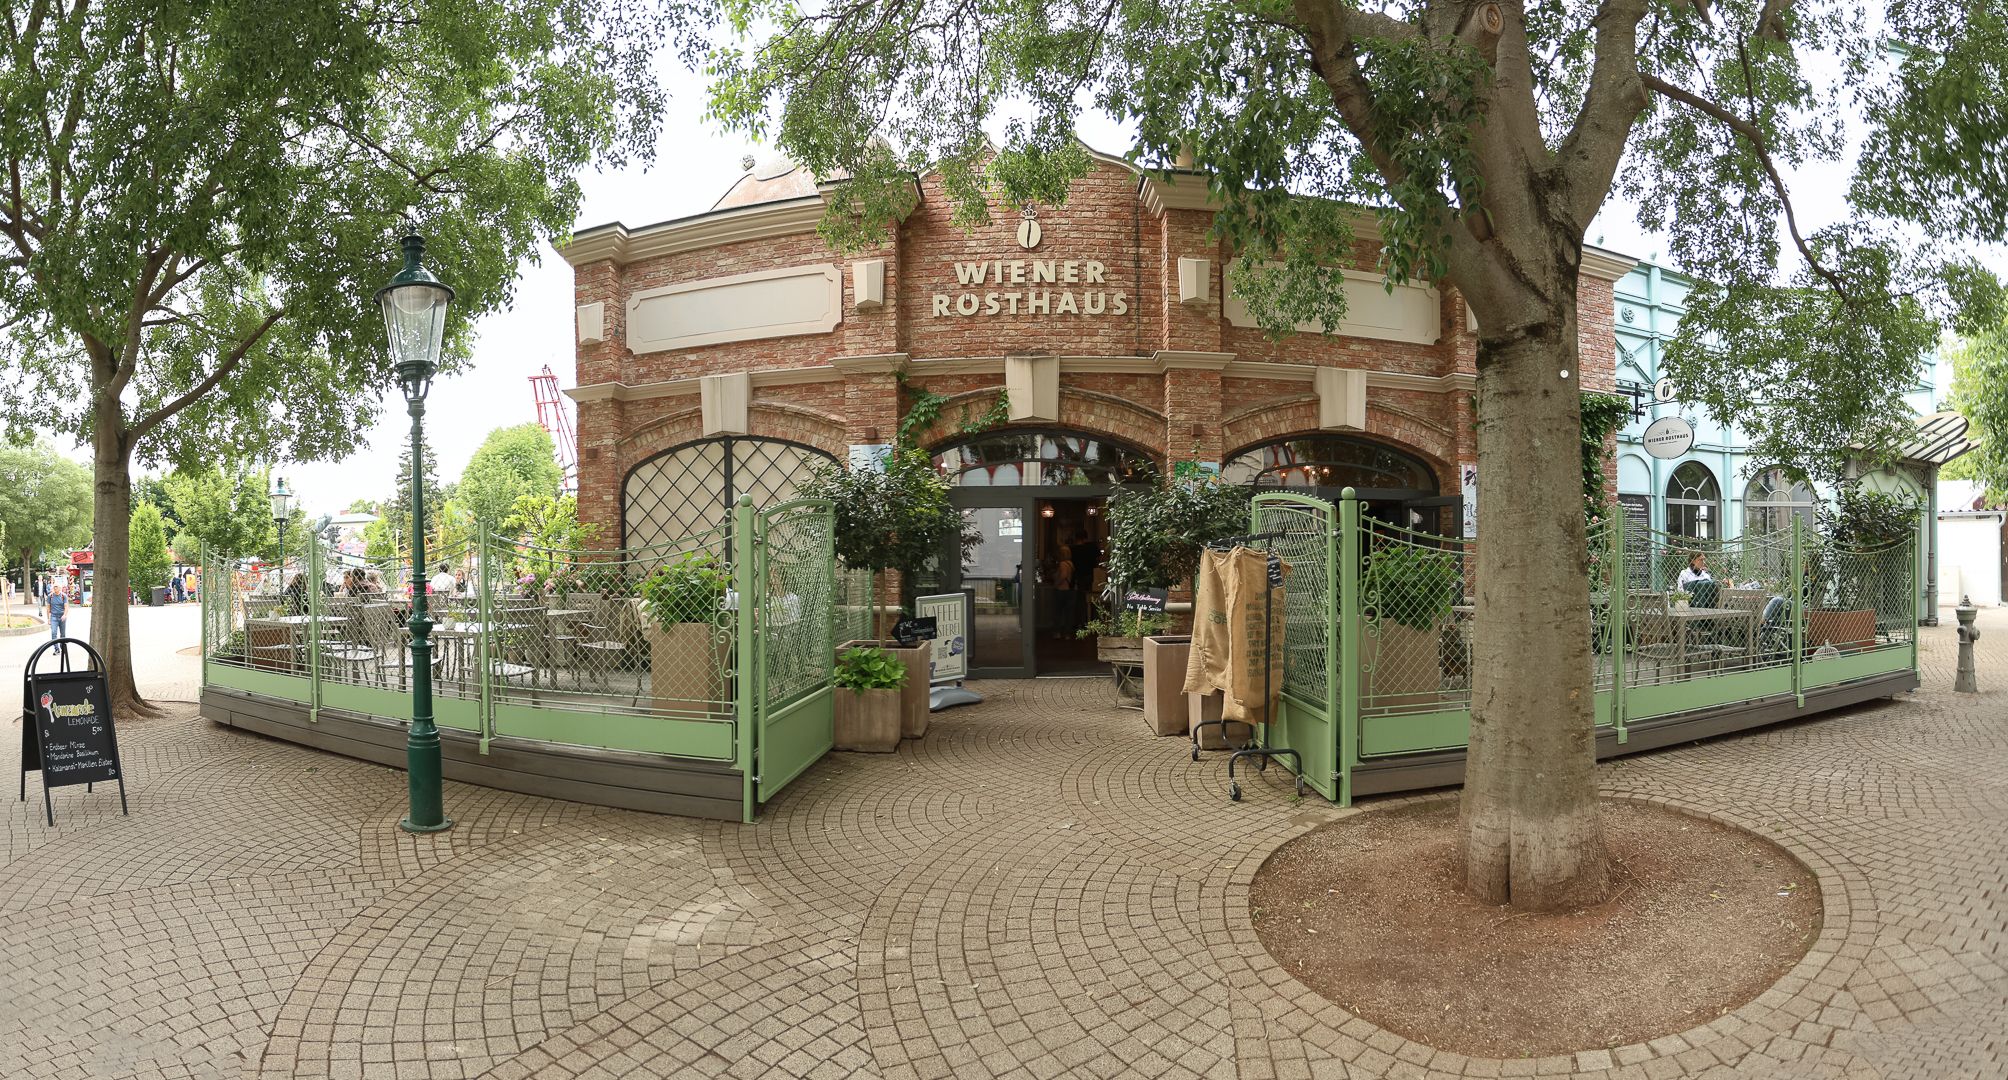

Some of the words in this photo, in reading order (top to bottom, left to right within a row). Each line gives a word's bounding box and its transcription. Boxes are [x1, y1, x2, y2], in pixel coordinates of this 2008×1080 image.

[954, 261, 1105, 284] WIENER
[932, 292, 1128, 317] RÖSTHAUS
[1665, 433, 1689, 441] RÖSTHAUS
[924, 603, 960, 621] KAFFEE
[937, 623, 960, 637] STEREI
[67, 715, 100, 726] LEMONADE
